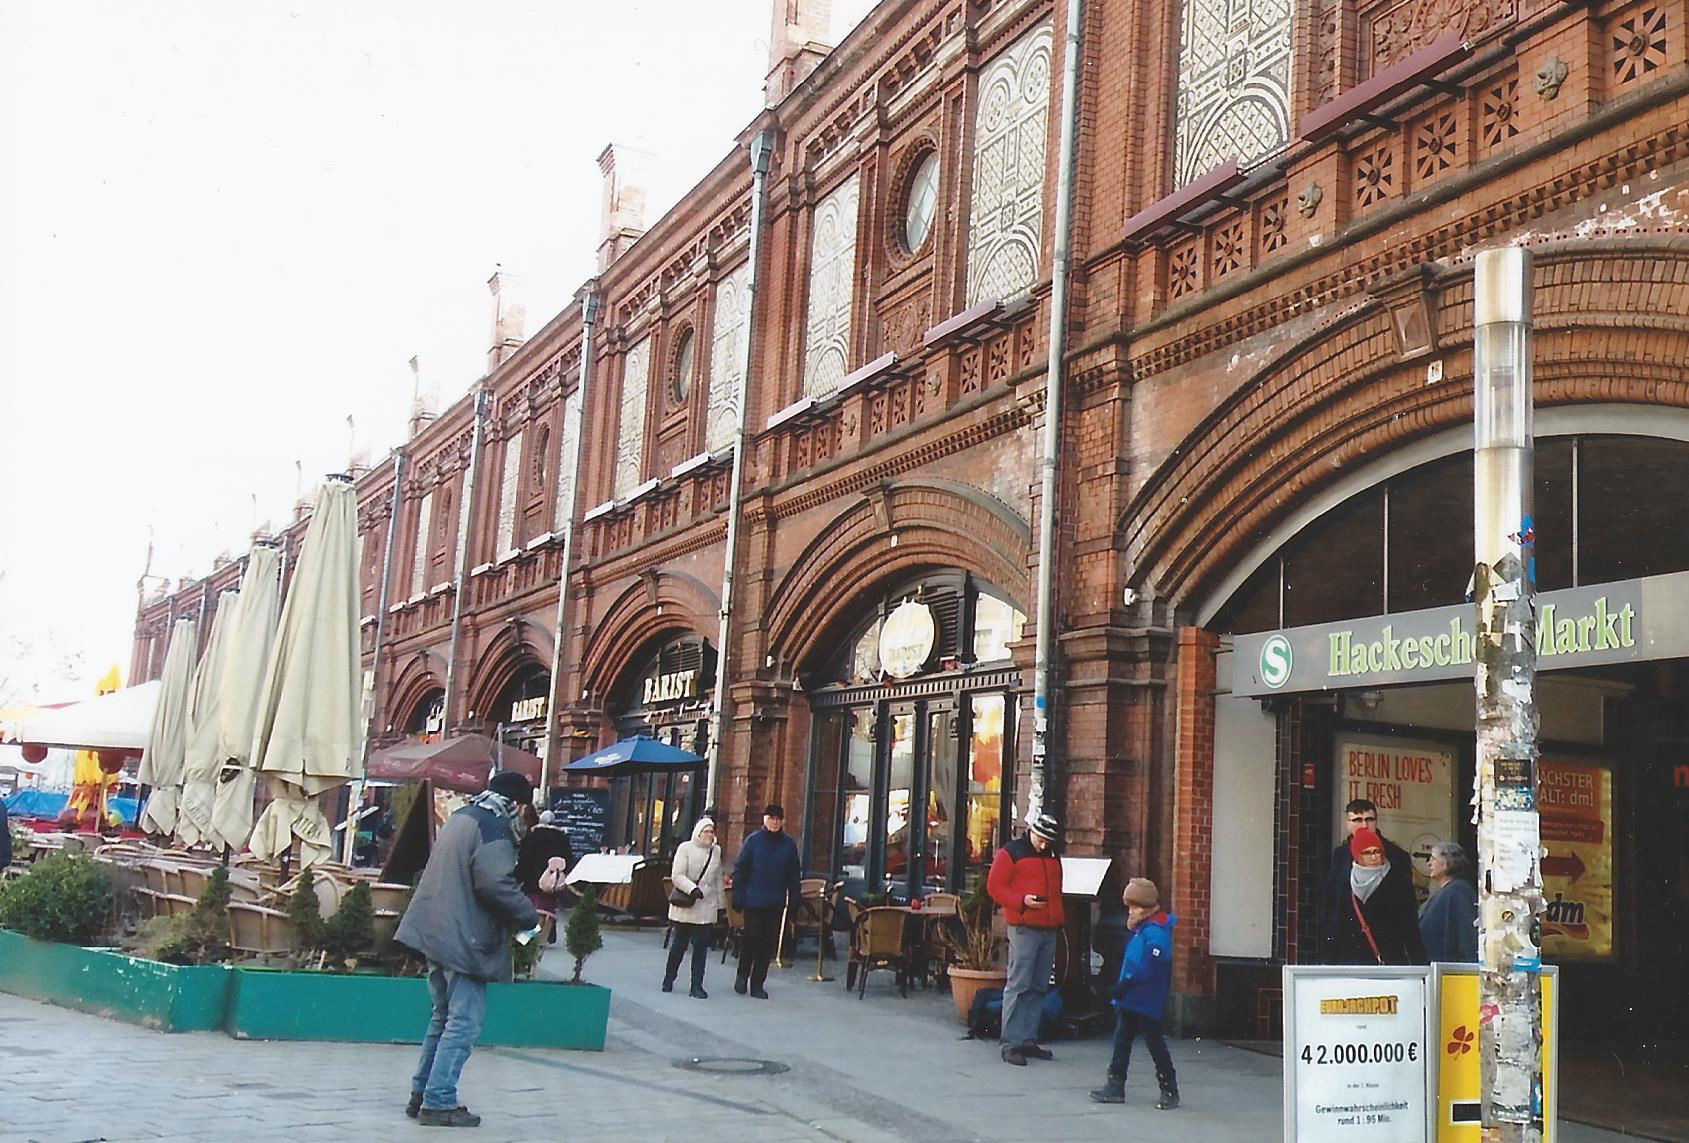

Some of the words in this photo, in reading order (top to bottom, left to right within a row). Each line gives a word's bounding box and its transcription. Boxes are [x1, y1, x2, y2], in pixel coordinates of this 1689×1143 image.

[1327, 616, 1478, 677] Hackesch
[643, 670, 694, 704] BARIST
[1349, 751, 1390, 779] BERLIN
[1395, 755, 1433, 784] LOVES
[1537, 767, 1593, 789] ÄCHSTER
[1349, 781, 1360, 802] IT
[1366, 782, 1401, 809] FRESH
[1541, 788, 1565, 805] ALT:
[1569, 790, 1594, 807] dm!
[1545, 893, 1584, 923] dm
[1338, 1115, 1355, 1126] rund
